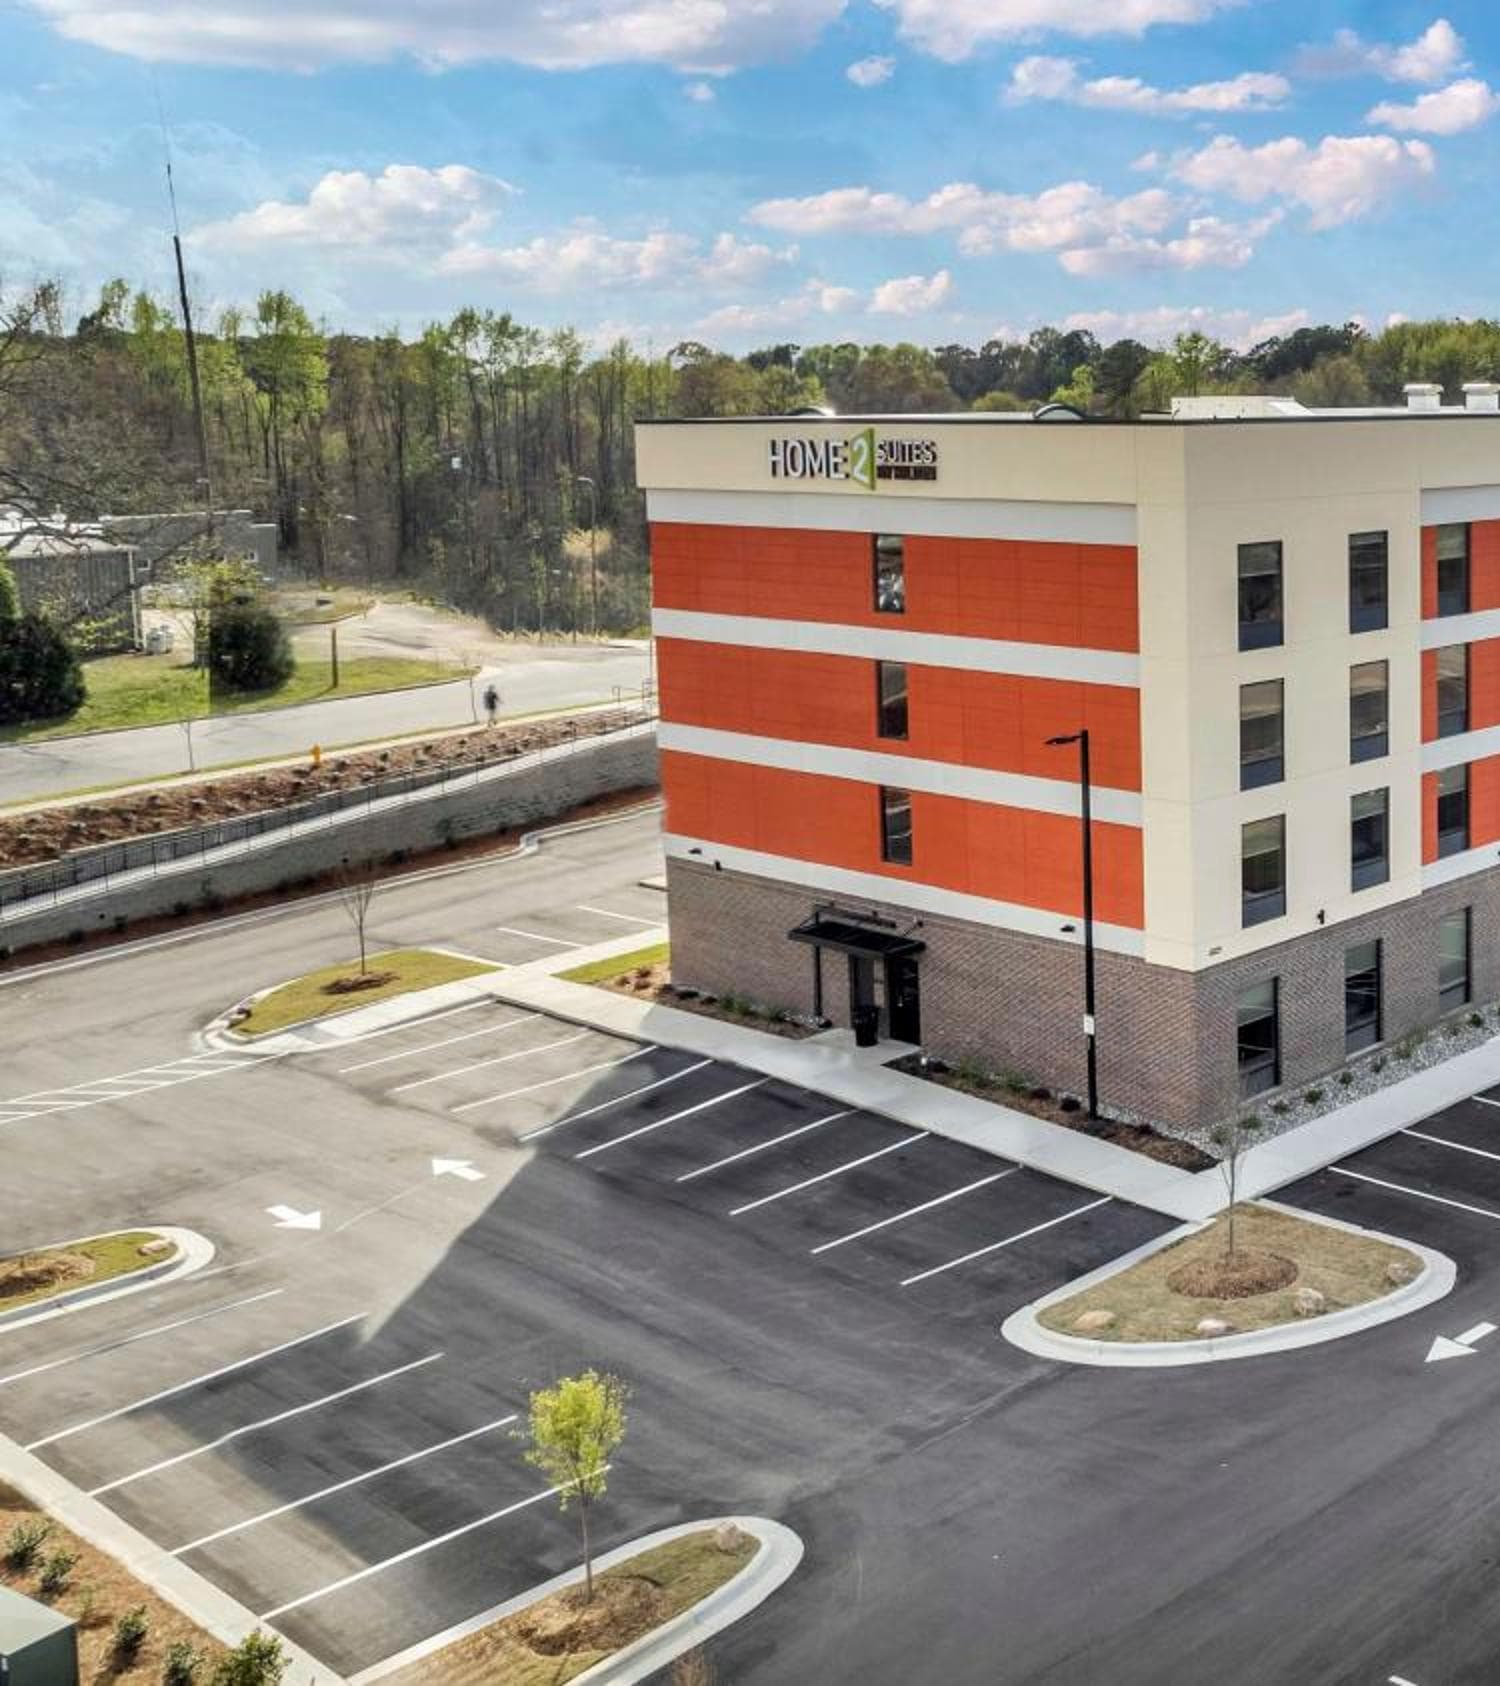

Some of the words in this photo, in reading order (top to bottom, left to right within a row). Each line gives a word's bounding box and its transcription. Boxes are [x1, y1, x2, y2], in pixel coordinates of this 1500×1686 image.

[767, 439, 849, 479] HOME
[852, 437, 869, 483] 2
[876, 439, 938, 464] SUITES
